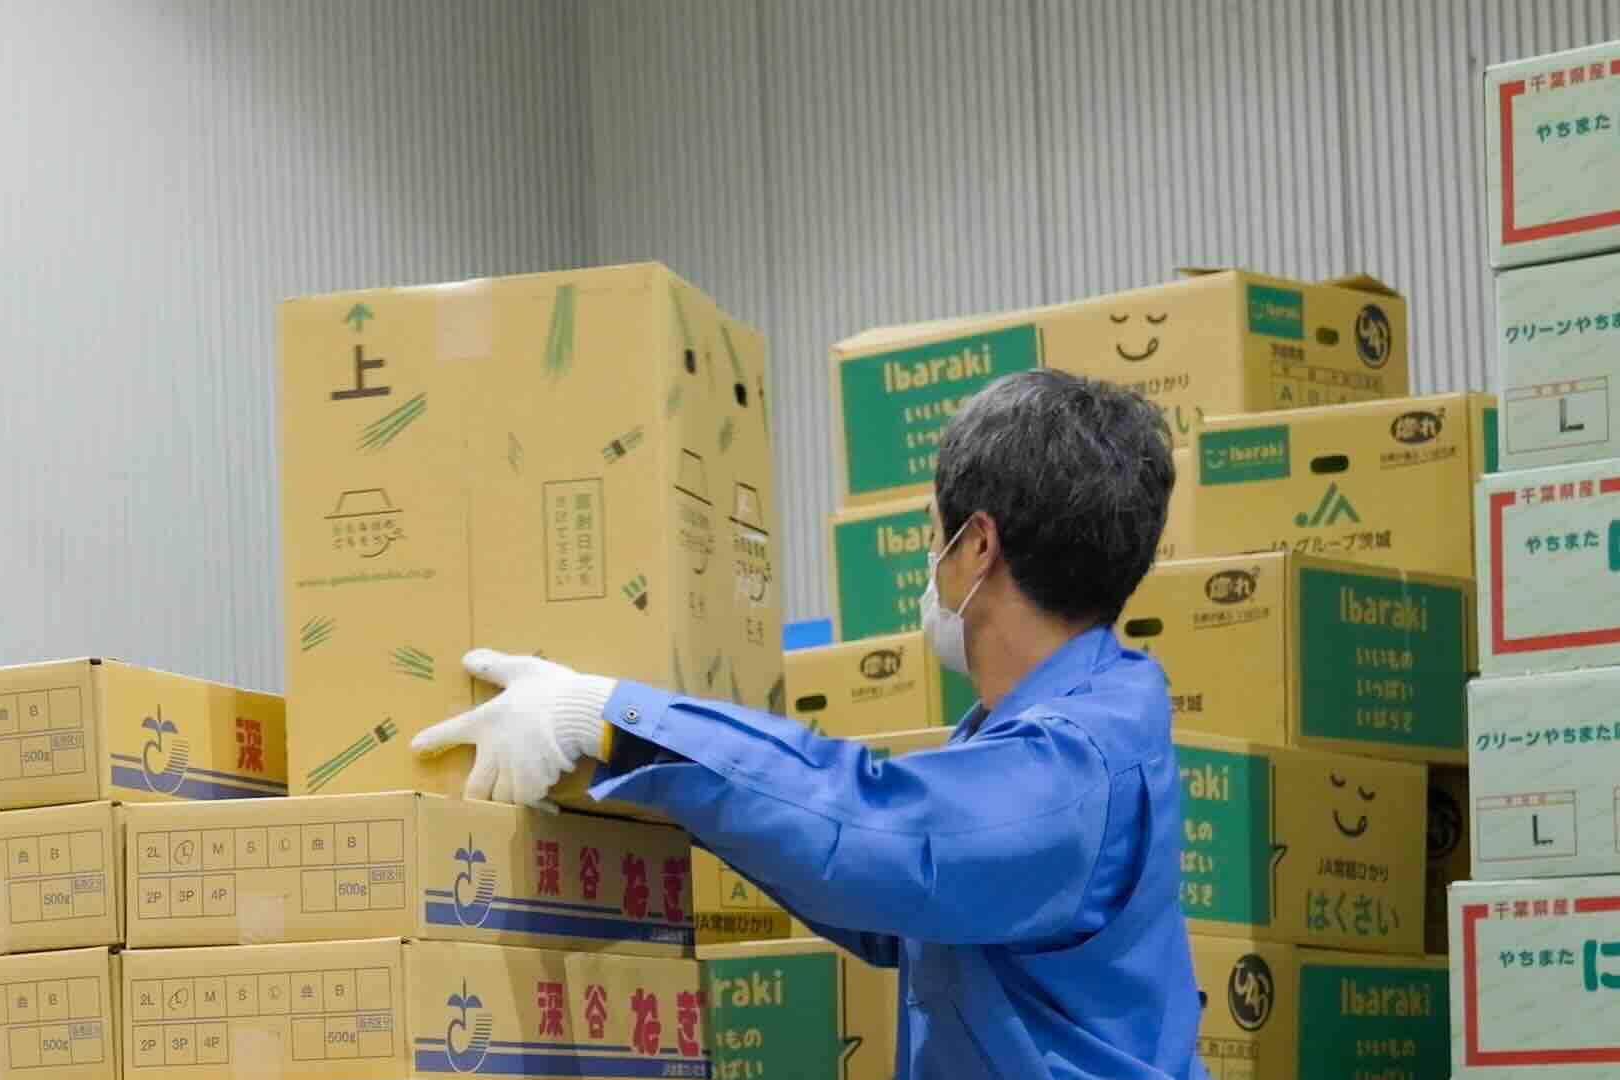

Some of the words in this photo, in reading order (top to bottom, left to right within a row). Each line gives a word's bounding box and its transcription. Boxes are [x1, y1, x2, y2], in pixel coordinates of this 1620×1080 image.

[1536, 113, 1610, 142] やちまた
[331, 345, 391, 401] 上
[883, 344, 992, 395] Ibaraki
[1560, 398, 1584, 433] L
[1526, 531, 1599, 554] やちまた
[1340, 587, 1427, 631] Ibaraki
[1180, 766, 1229, 801] raki
[1532, 815, 1553, 846] L
[213, 843, 223, 854] M
[732, 882, 747, 900] A
[1307, 890, 1399, 935] はくさい
[1499, 949, 1574, 968] やちまた
[204, 991, 216, 1002] M
[712, 971, 784, 1007] raki
[1340, 977, 1431, 1016] Ibaraki
[537, 982, 705, 1056] 深谷ねぎ
